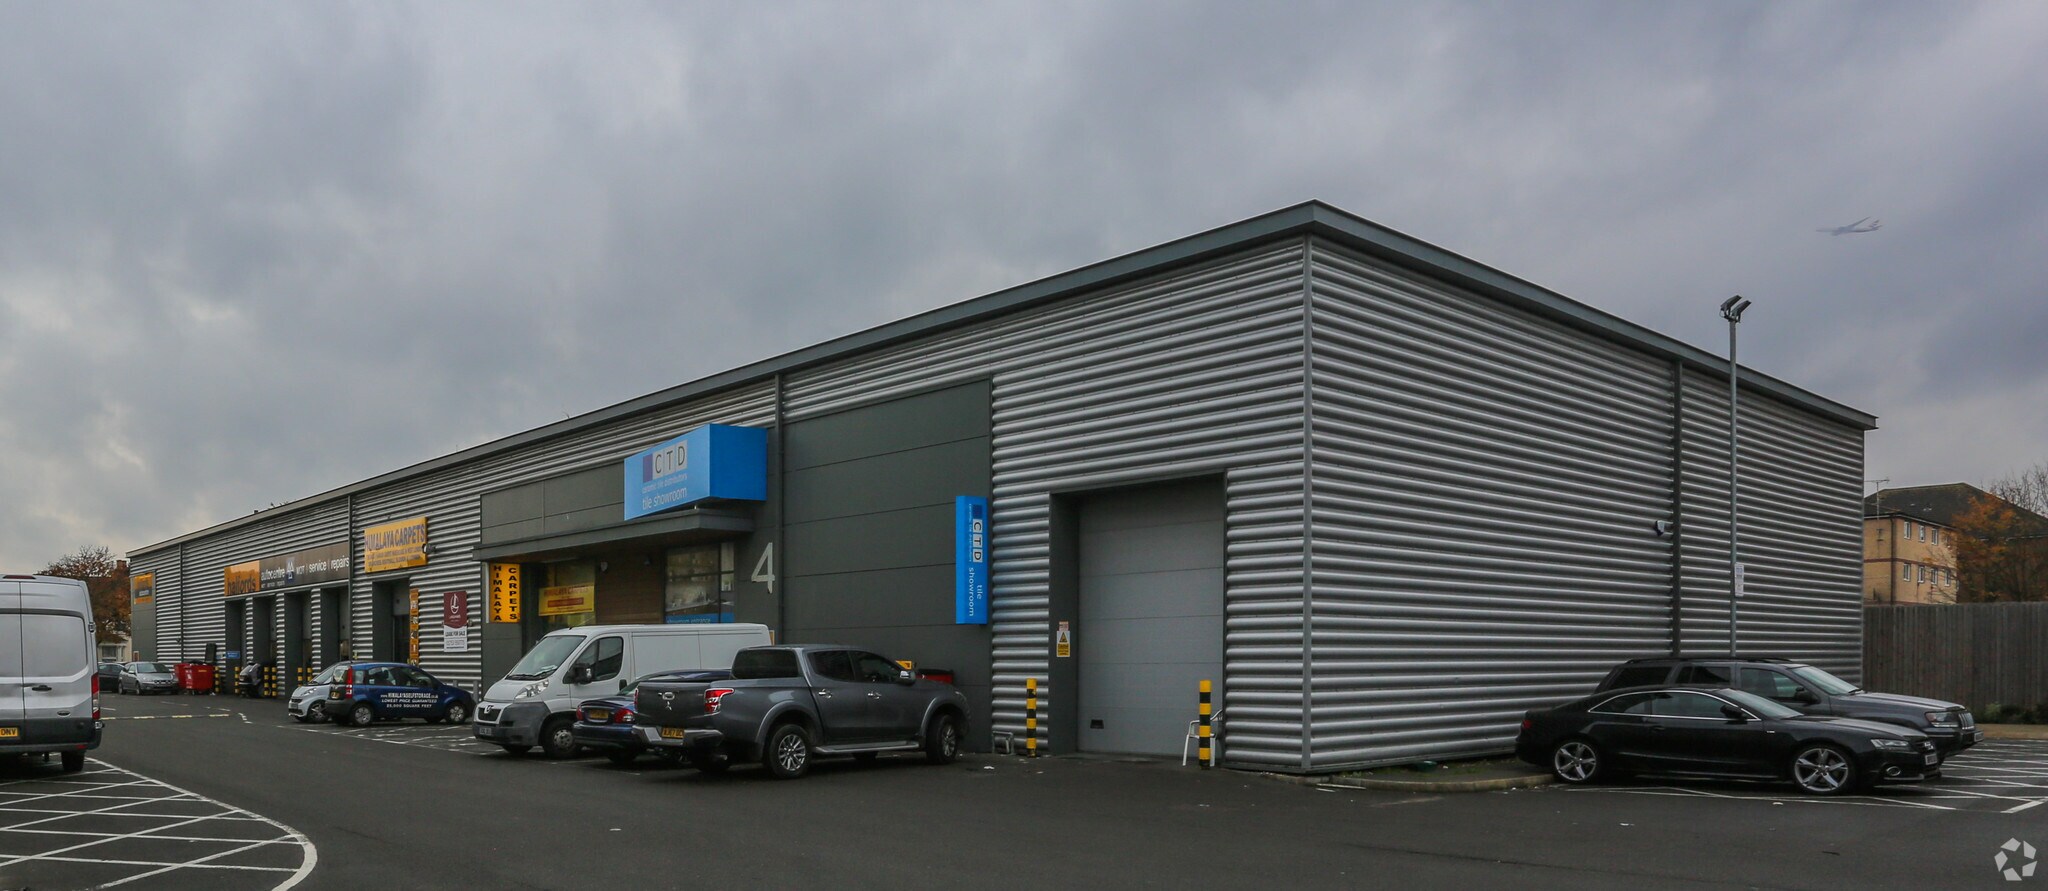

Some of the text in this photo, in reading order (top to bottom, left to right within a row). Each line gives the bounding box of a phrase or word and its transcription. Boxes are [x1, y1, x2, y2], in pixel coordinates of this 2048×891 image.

[642, 487, 688, 510] tile showroom
[365, 523, 425, 551] HIMALAYA CARPETS
[261, 567, 285, 581] autocentre
[308, 560, 327, 573] service
[330, 555, 350, 571] repairs
[751, 542, 776, 594] 4
[493, 565, 502, 621] HIMALAYA
[508, 567, 518, 620] CARPETS
